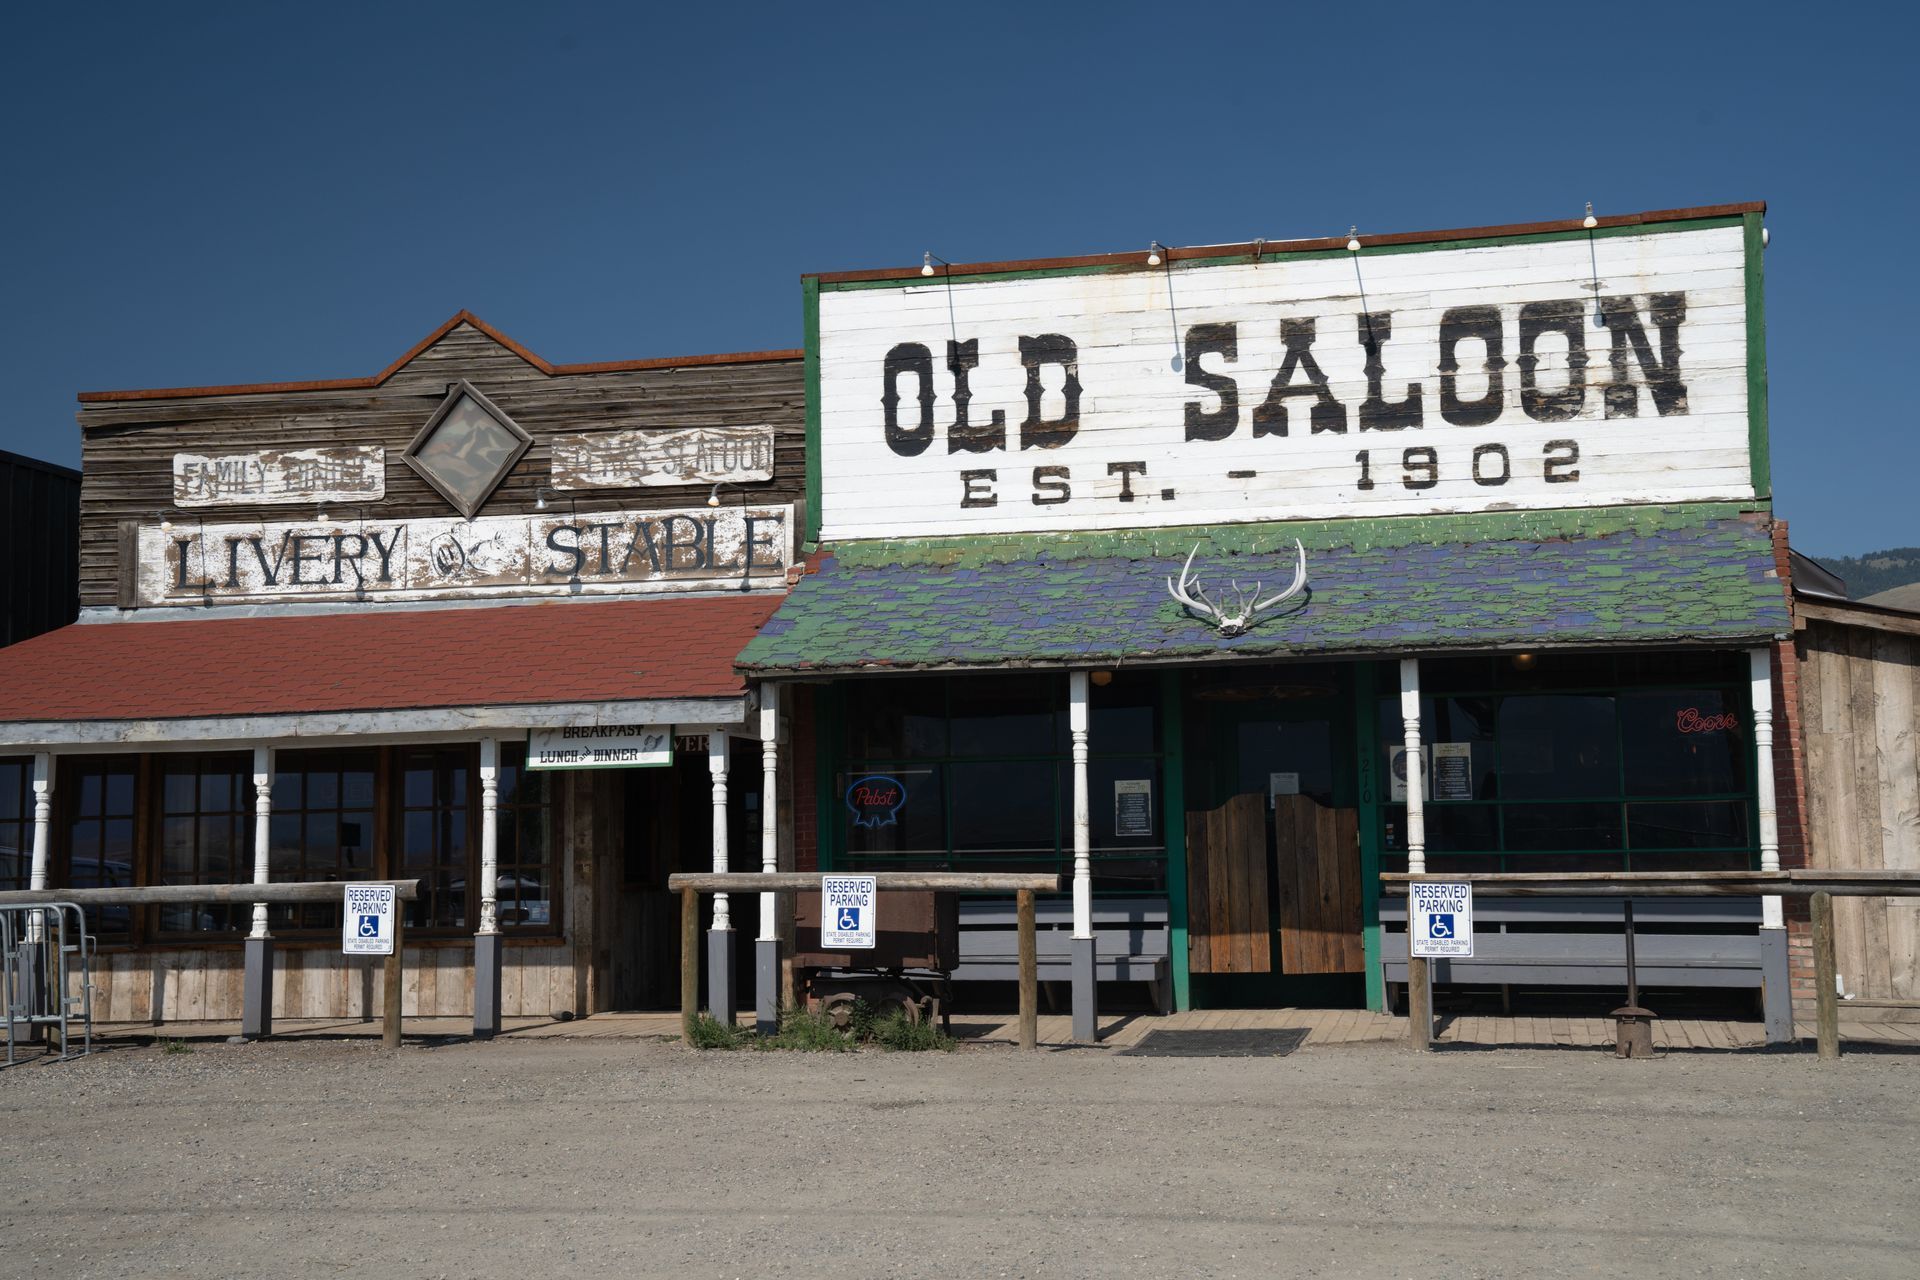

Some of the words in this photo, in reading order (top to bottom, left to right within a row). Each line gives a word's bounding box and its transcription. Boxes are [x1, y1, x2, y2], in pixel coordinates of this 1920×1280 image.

[880, 333, 1084, 457] OLD
[1184, 290, 1690, 442] SALOON
[183, 460, 269, 498] FAMILY
[960, 461, 1175, 509] EST.
[1355, 439, 1580, 491] 1902
[173, 524, 404, 589] LIVERY
[545, 515, 785, 576] STABLE
[1677, 707, 1739, 733] Coors
[563, 724, 645, 739] BREAKFAST
[540, 749, 579, 764] LUNCH
[579, 746, 592, 762] and
[856, 786, 898, 806] Pabst
[826, 881, 873, 893] RESERVED
[1414, 885, 1467, 899] RESERVED
[348, 889, 391, 902] RESERVED
[830, 894, 868, 907] PARKING
[351, 902, 388, 914] PARKING
[1419, 899, 1464, 913] PARKING
